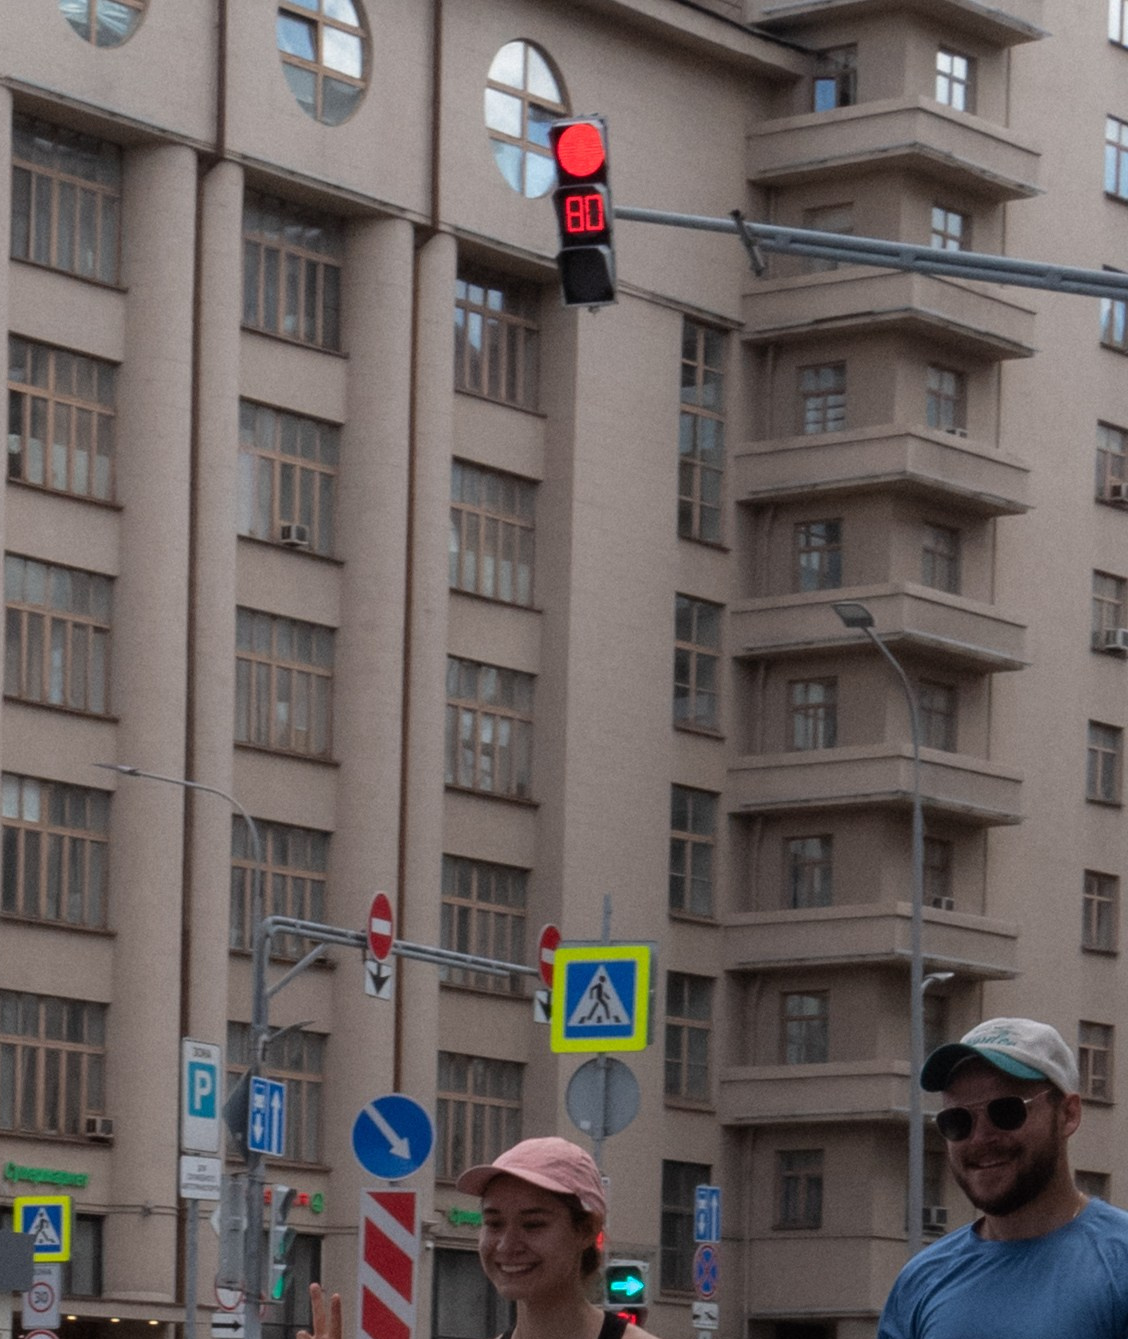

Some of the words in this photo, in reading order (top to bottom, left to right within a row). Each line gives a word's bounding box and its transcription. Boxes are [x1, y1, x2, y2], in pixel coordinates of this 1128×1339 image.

[566, 194, 604, 232] 80
[194, 1070, 212, 1109] P
[34, 1290, 49, 1304] 30
